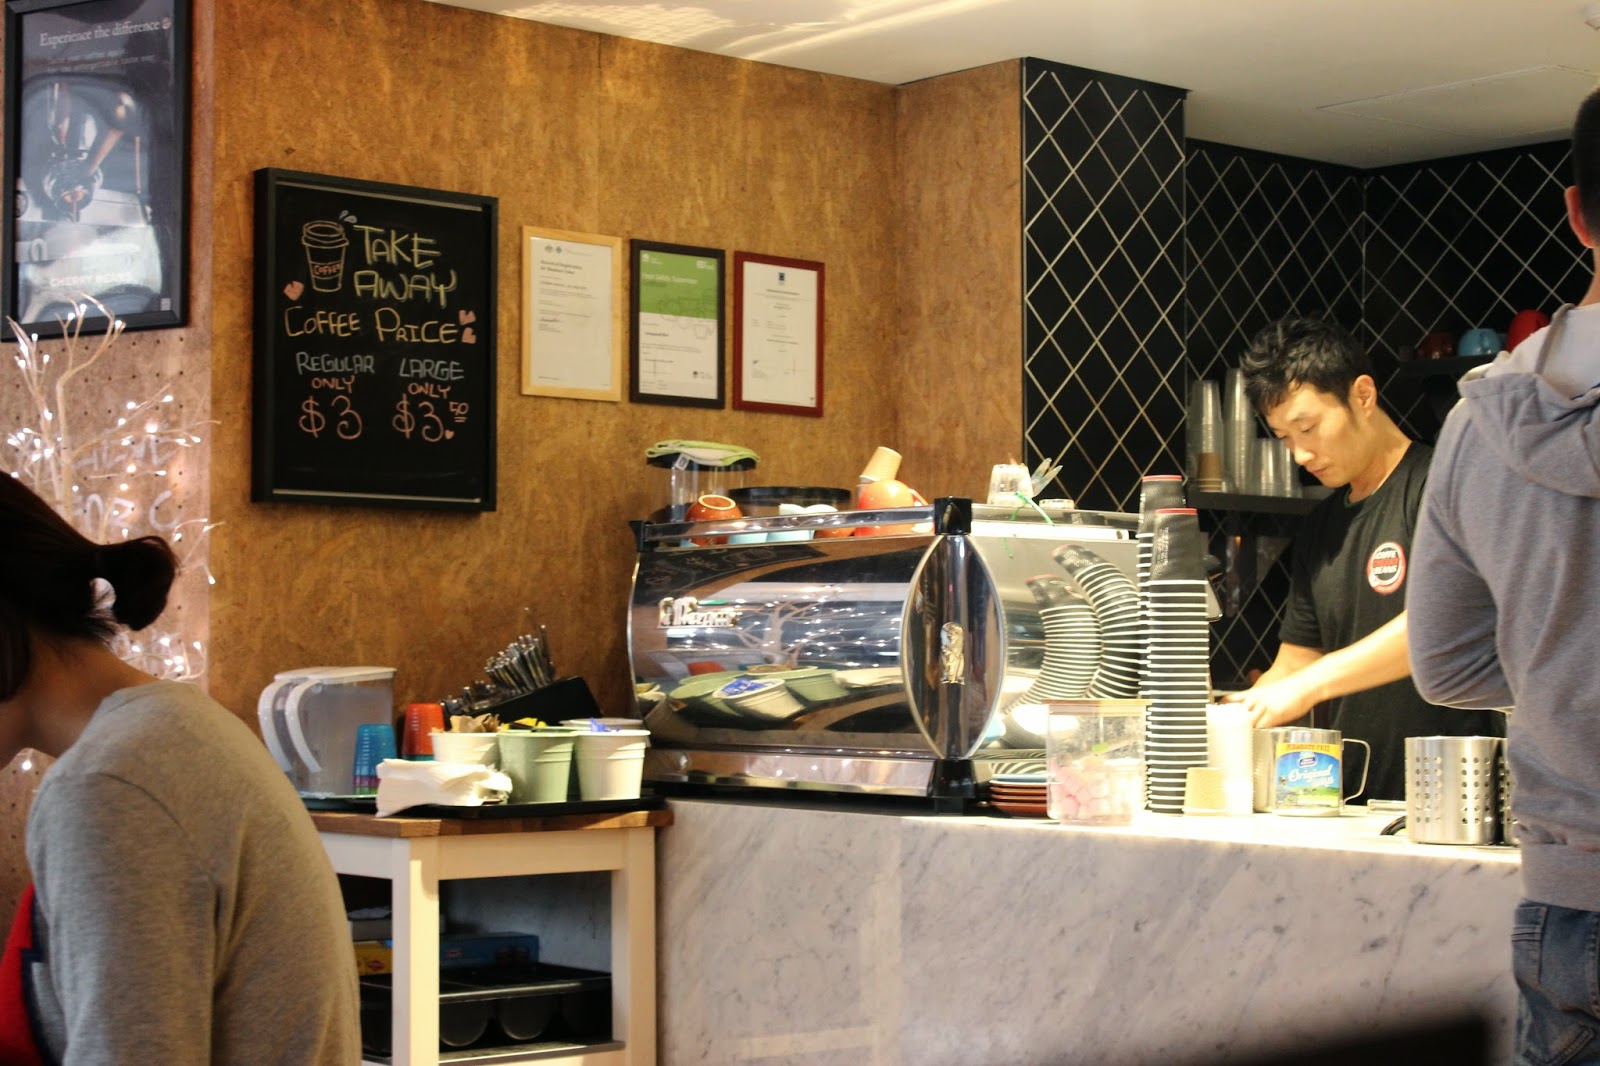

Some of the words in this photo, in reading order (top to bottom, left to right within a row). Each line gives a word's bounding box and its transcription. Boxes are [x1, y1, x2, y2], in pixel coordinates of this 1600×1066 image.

[40, 31, 92, 49] Experience
[94, 25, 110, 39] the
[112, 20, 160, 36] difference
[353, 225, 441, 269] TAKE
[354, 269, 457, 308] AWAY
[285, 306, 360, 337] COFFEE
[375, 307, 459, 344] PRICE
[296, 352, 375, 375] REGULAR
[400, 357, 464, 381] LARGE
[311, 375, 355, 393] ONLY
[408, 382, 451, 399] ONLY
[1288, 764, 1334, 783] Original
